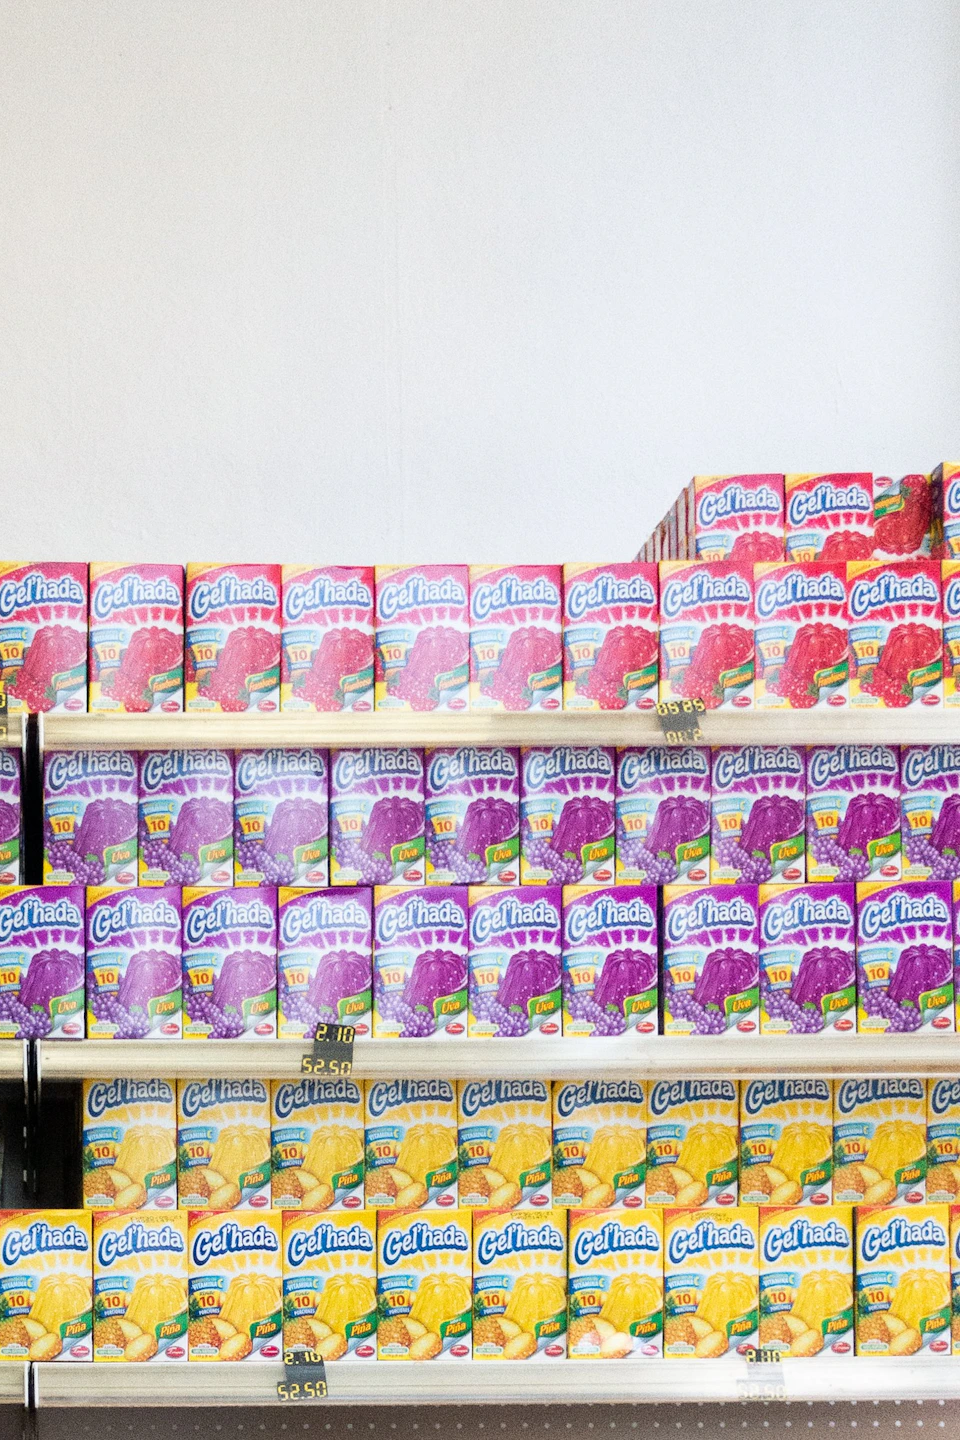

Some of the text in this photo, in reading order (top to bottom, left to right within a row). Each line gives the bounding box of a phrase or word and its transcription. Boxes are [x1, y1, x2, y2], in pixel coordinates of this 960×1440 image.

[704, 488, 782, 522] Gel'hada
[794, 487, 872, 521] Gel'hada
[0, 575, 82, 616] Gel'hada
[474, 577, 557, 618] Gel'hada
[760, 573, 843, 614] Gel'hada
[4, 648, 19, 660] 10
[684, 846, 703, 860] Uva
[187, 899, 273, 942] Gel'hada
[473, 898, 559, 941] Gel'hada
[765, 895, 851, 938] Gel'hada
[772, 970, 787, 982] 10
[536, 1001, 555, 1014] Uva
[316, 1023, 354, 1044] 2.10
[302, 1058, 351, 1075] 52.50
[189, 1146, 204, 1157] 10
[150, 1172, 170, 1188] Piña
[431, 1170, 451, 1186] Piña
[4, 1223, 87, 1265] Gel'hada
[194, 1223, 277, 1265] Gel'hada
[479, 1222, 562, 1264] Gel'hada
[765, 1219, 848, 1261] Gel'hada
[9, 1295, 25, 1307] 10
[484, 1294, 500, 1306] 10
[255, 1321, 276, 1337] Piña
[827, 1317, 848, 1333] Piña
[277, 1381, 327, 1401] 52.50
